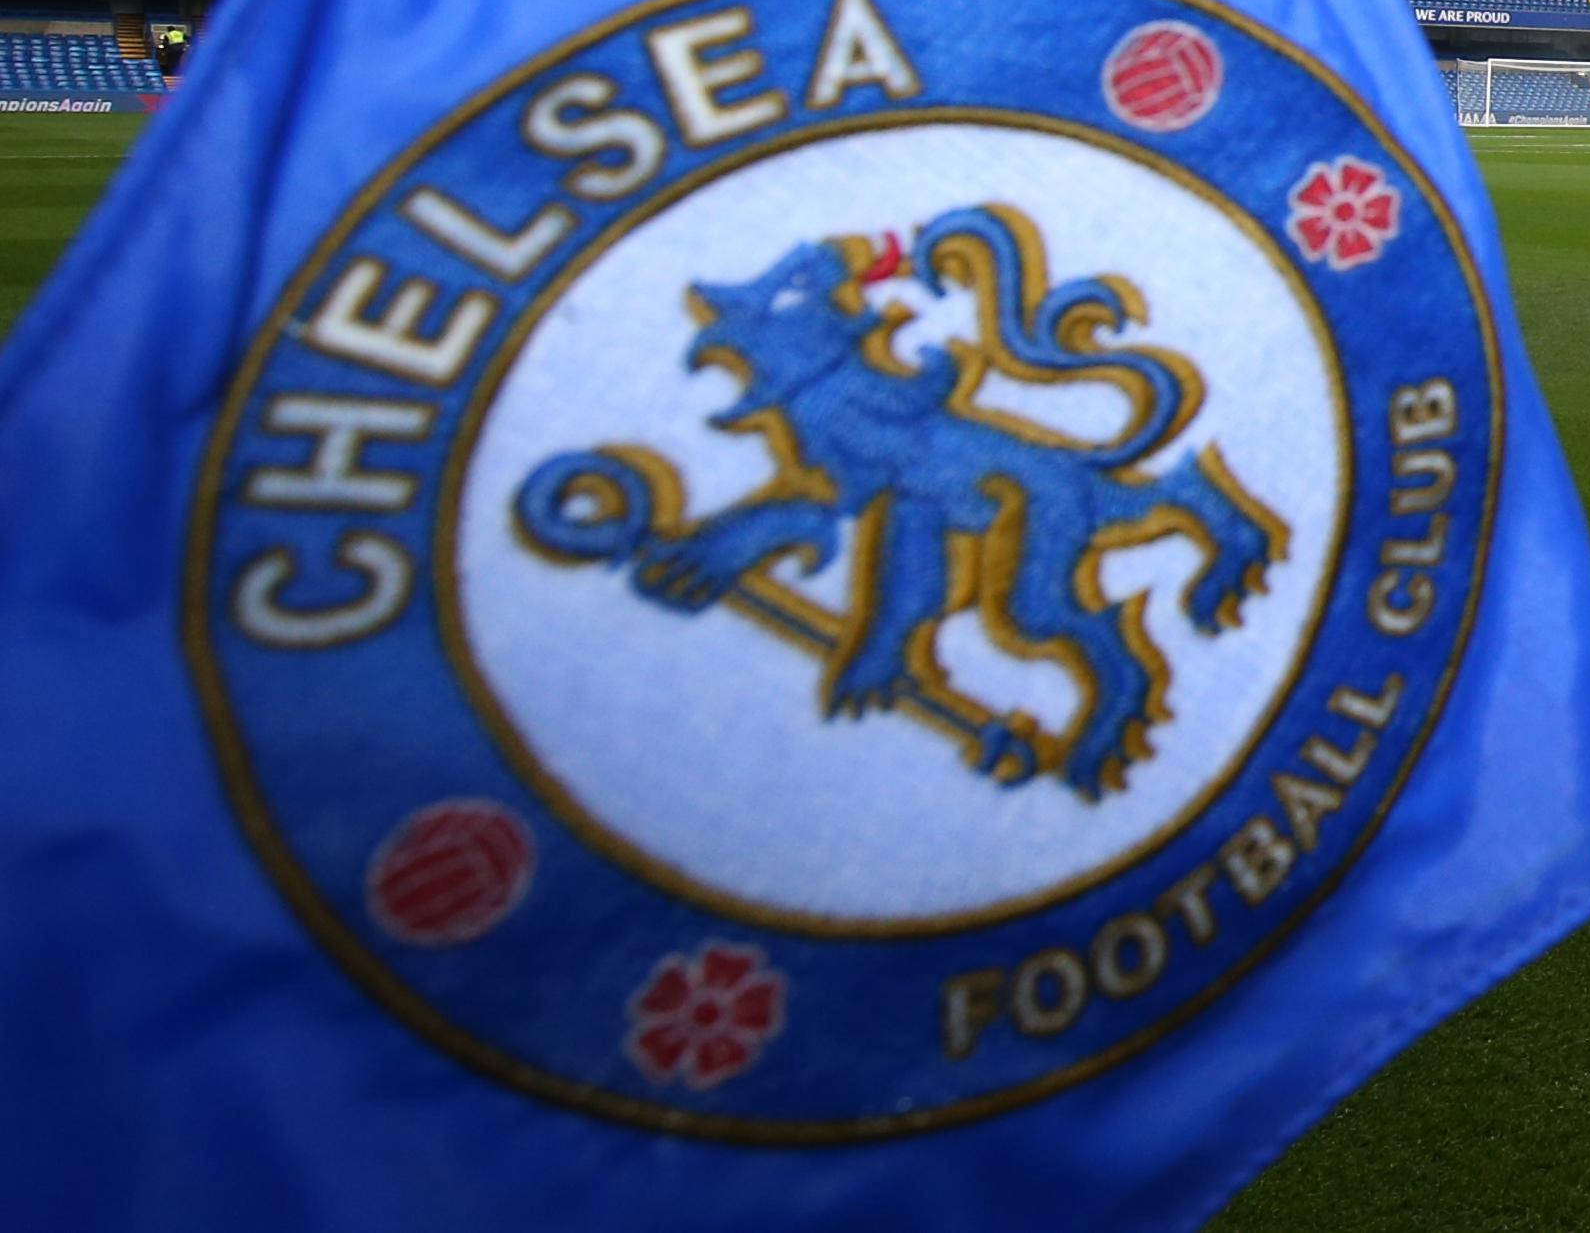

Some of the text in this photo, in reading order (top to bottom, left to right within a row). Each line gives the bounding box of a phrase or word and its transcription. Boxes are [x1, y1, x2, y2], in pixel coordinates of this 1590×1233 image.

[1415, 8, 1510, 24] WE ARE PROUD
[940, 374, 1462, 1061] FOOTBALL CLUB
